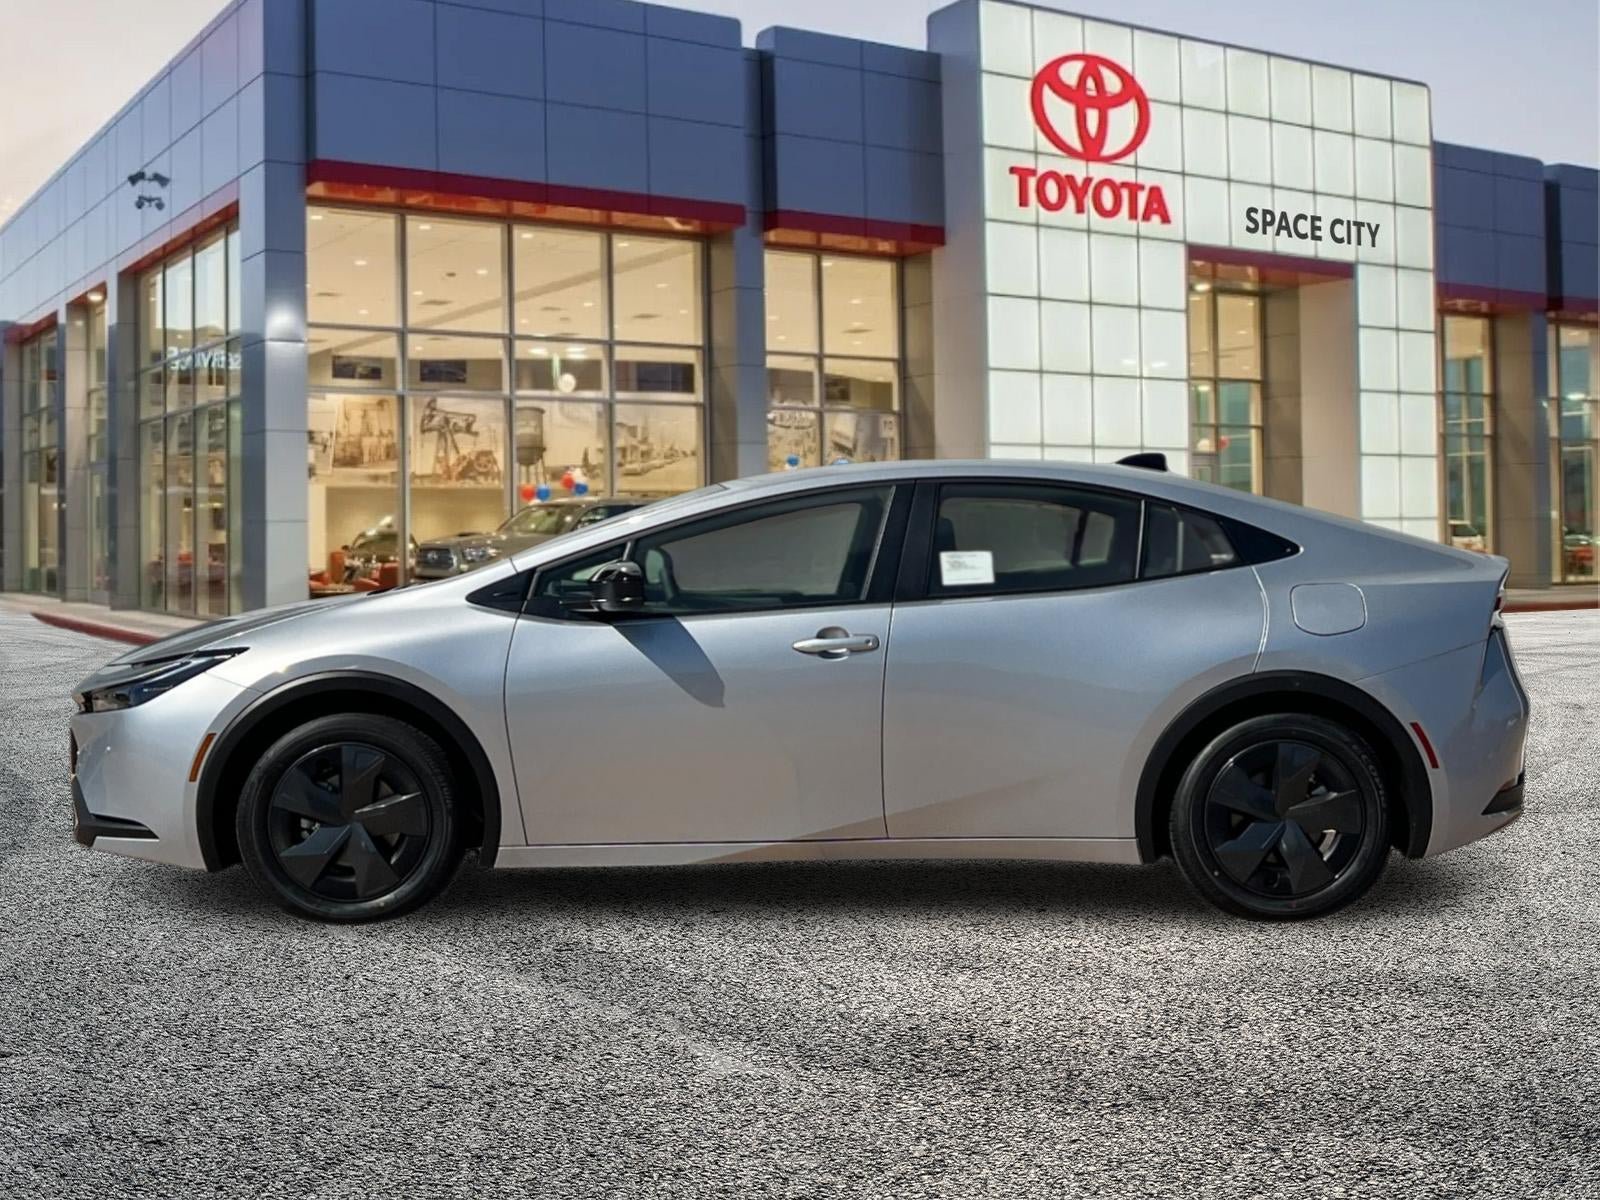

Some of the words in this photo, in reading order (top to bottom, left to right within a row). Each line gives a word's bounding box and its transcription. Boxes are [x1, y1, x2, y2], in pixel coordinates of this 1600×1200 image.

[1009, 166, 1171, 224] TOYOTA
[1245, 206, 1322, 242] SPACE
[1329, 217, 1380, 248] CITY
